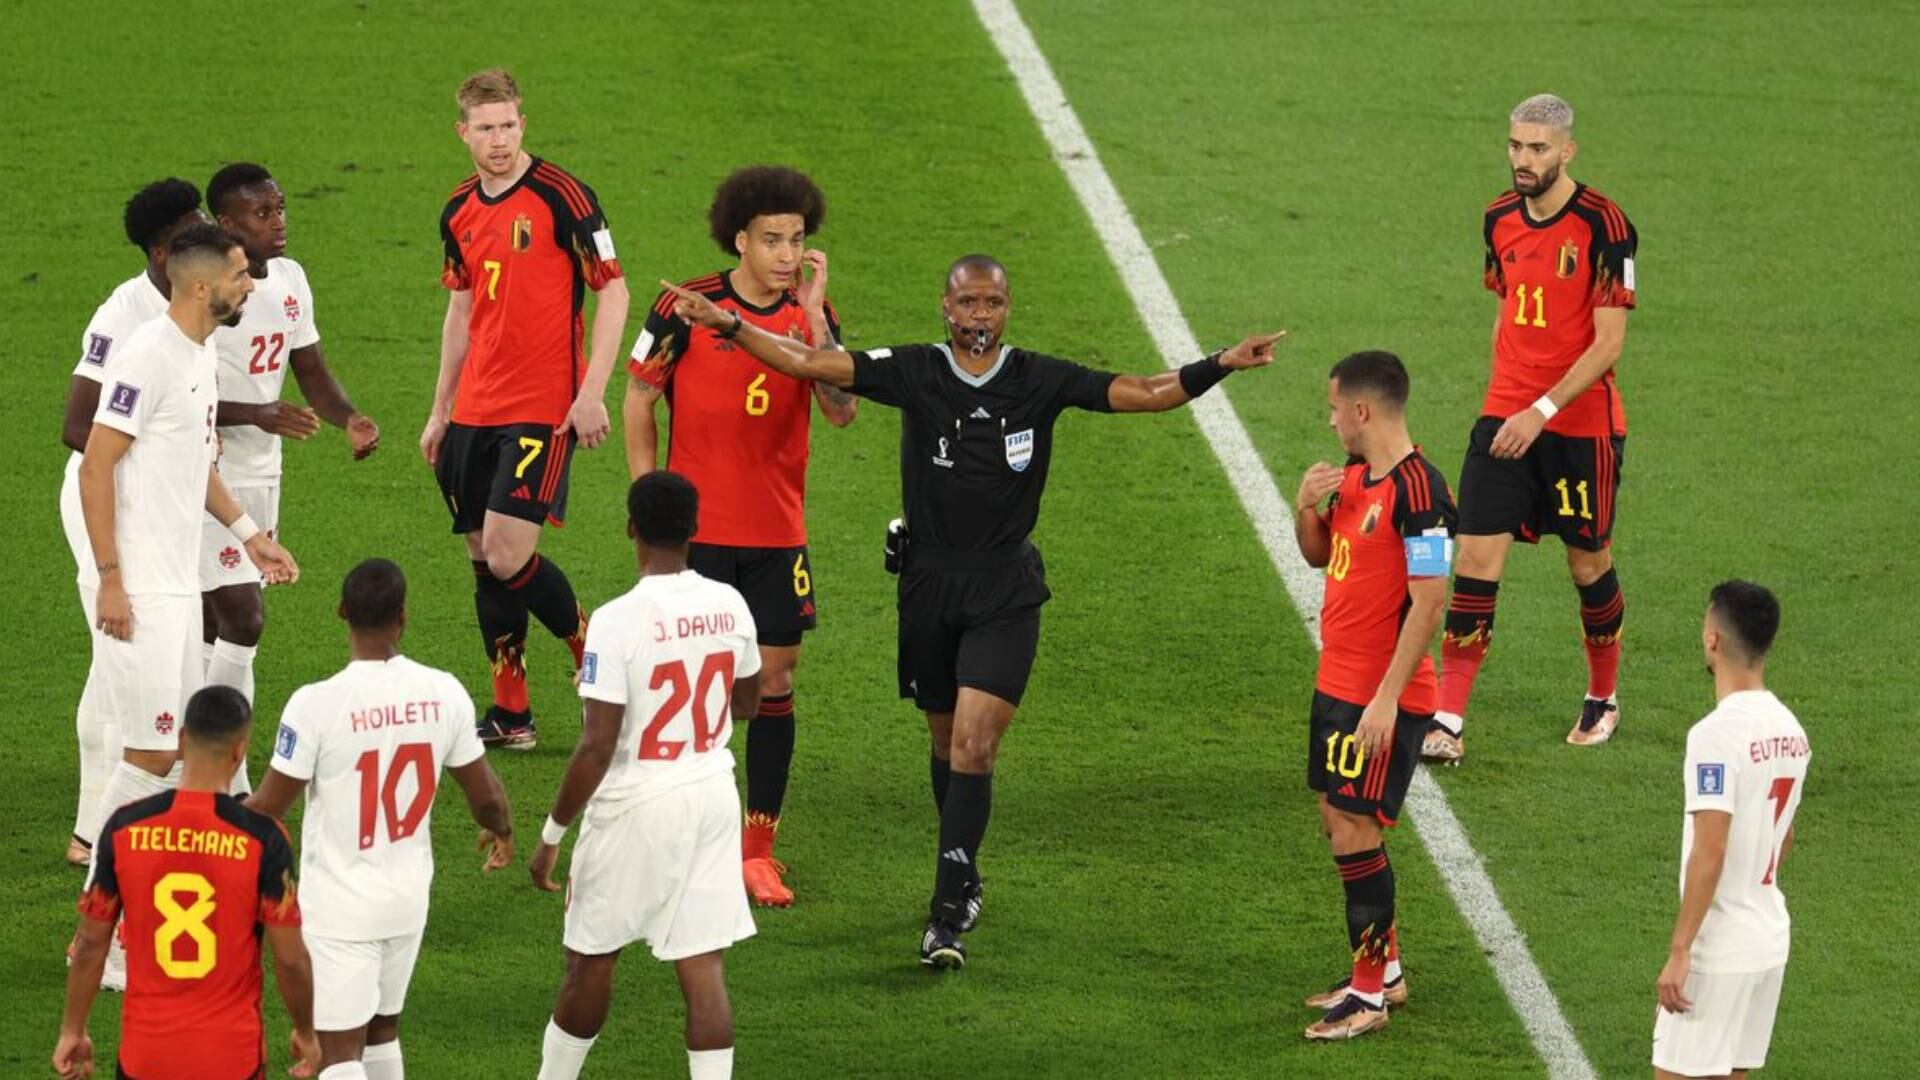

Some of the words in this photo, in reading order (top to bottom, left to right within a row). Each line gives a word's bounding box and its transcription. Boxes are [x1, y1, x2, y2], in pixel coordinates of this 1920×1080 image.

[483, 260, 501, 300] 7
[1514, 283, 1547, 328] 11
[247, 331, 285, 375] 22
[745, 373, 770, 416] 6
[515, 436, 544, 478] 7
[1008, 432, 1031, 447] FIFA
[1555, 478, 1592, 520] 11
[793, 554, 811, 597] 6
[1327, 531, 1351, 582] 10
[655, 621, 673, 642] J.
[677, 611, 736, 639] DAVID
[351, 700, 440, 731] HOILETT
[637, 649, 736, 762] 20
[1326, 729, 1365, 780] 10
[355, 741, 437, 851] 10
[128, 825, 249, 861] TIELEMANS
[1762, 775, 1797, 887] 7
[153, 872, 217, 979] 8
